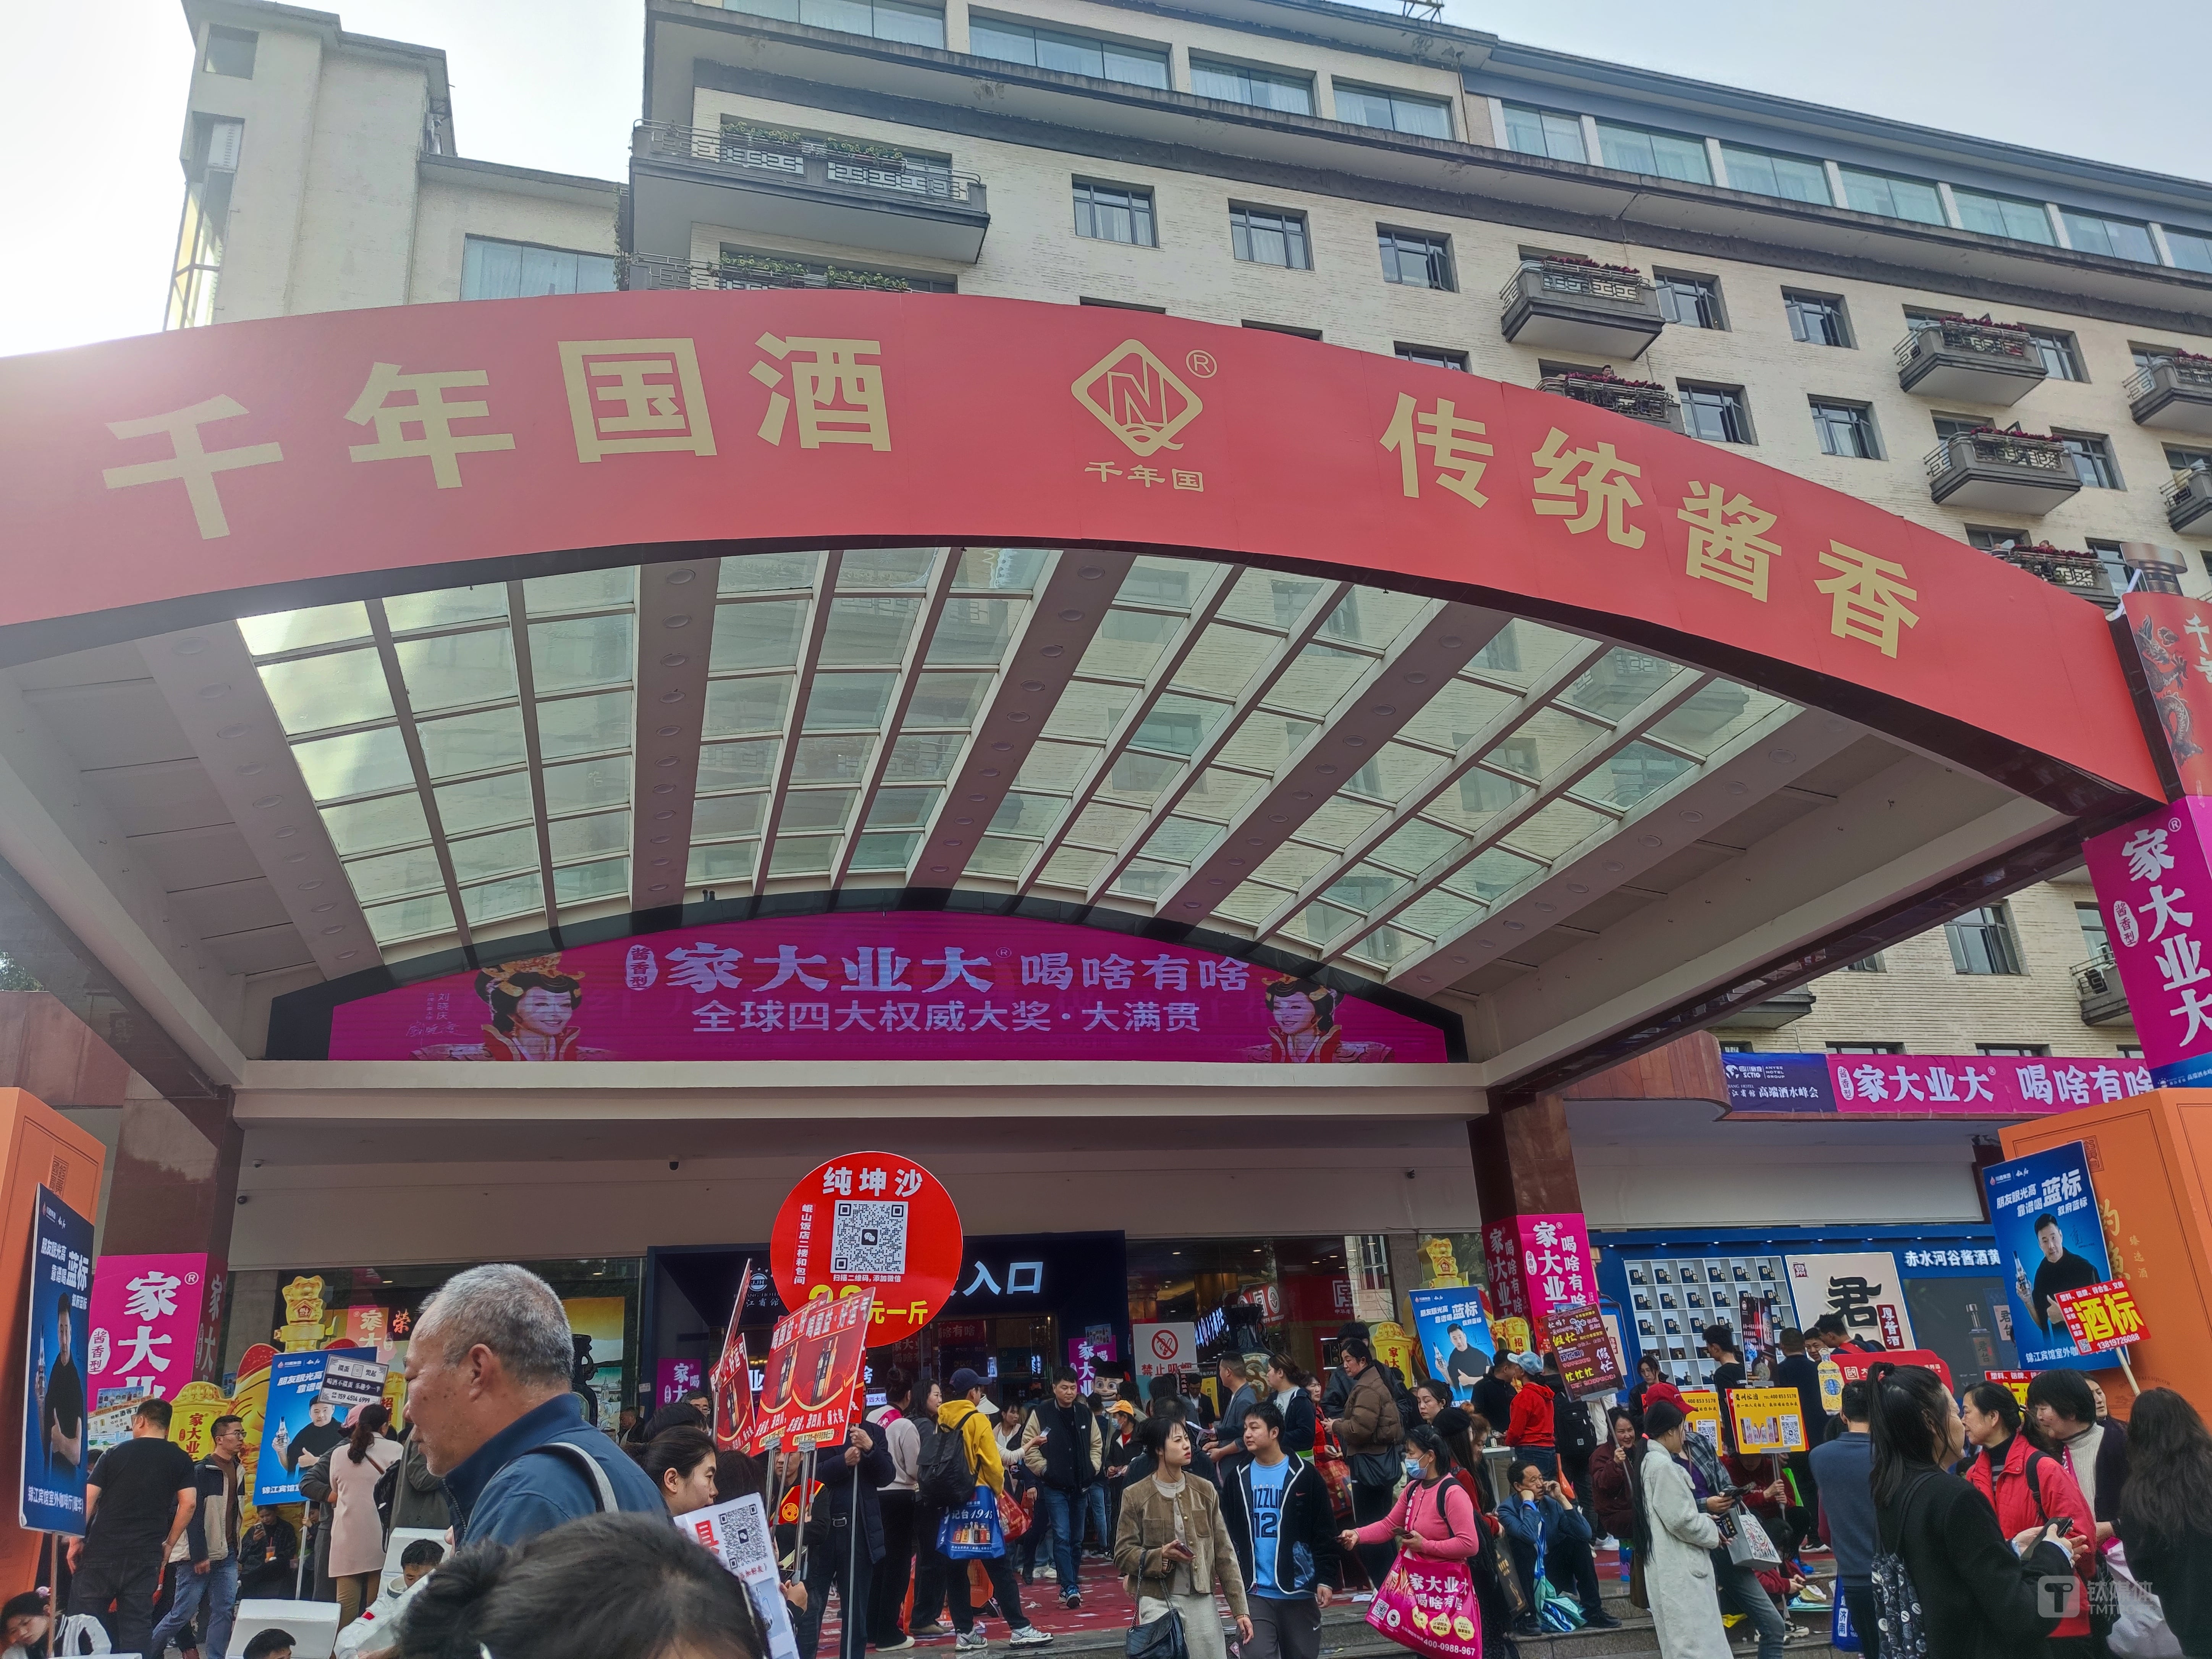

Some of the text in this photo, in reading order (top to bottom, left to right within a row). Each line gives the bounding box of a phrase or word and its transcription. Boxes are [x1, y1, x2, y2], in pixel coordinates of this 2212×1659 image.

[102, 331, 893, 540] 千年国酒
[1084, 461, 1204, 492] 千年国
[1381, 390, 1920, 660] 传统酱香
[2115, 903, 2136, 946] 酱香型
[2121, 828, 2212, 1048] 家大业大
[629, 946, 651, 988] 酱香型
[665, 941, 1251, 993] 家大业大 喝啥有啥
[437, 993, 450, 1020] 刘晓庆
[692, 999, 1202, 1033] 全球四大权威大奖·大满贯
[1728, 1089, 1756, 1098] 江賓館
[1758, 1086, 1819, 1098] 高端酒水峰会
[1853, 1064, 2153, 1105] 家大业大 喝啥有啥
[822, 1166, 923, 1197] 纯坤沙
[1997, 1183, 2037, 1210] 朋友眼光高
[2041, 1168, 2083, 1207] 蓝标
[2017, 1197, 2043, 1218] 靠谱喝
[2057, 1196, 2088, 1216] 叙府蓝标
[40, 1237, 67, 1262] 朋友眼光高
[794, 1204, 813, 1285] 岷山饭店二楼和包间
[1905, 1249, 2001, 1267] 赤水河谷酱酒黄
[66, 1250, 89, 1291] 蓝标
[950, 1260, 1044, 1297] 入口
[1533, 1221, 1568, 1314] 家大业
[1560, 1235, 1587, 1306] 喝啥有啥
[1420, 1305, 1449, 1318] 朋友眼光高
[1451, 1301, 1479, 1320] 蓝标
[1827, 1276, 1886, 1351] 君
[2072, 1291, 2145, 1343] 酒标
[201, 1273, 222, 1381] 家大
[2097, 1333, 2140, 1350] 13819726088
[89, 1329, 109, 1373] 酱香型
[276, 1370, 324, 1386] 朋友眼光高
[1565, 1367, 1594, 1383] 忙忙忙
[186, 1412, 204, 1460] 家大业
[1254, 1512, 1277, 1538] 12
[1409, 1572, 1469, 1596] 家大业大
[1415, 1593, 1463, 1611] 喝啥有啥
[1423, 1638, 1476, 1656] 400-0988-967
